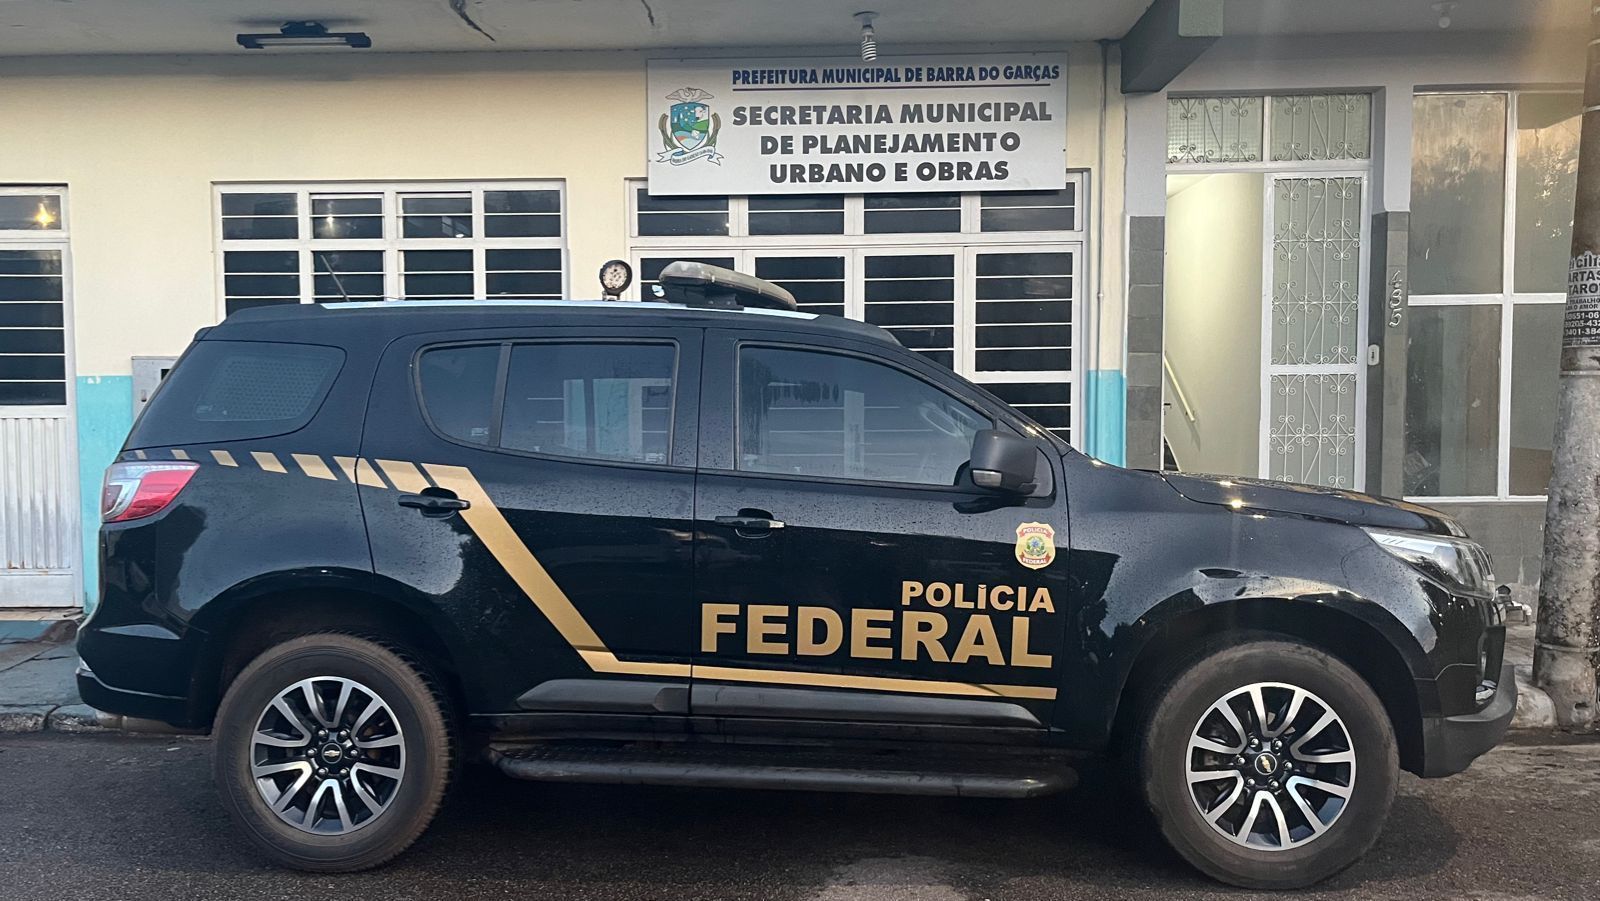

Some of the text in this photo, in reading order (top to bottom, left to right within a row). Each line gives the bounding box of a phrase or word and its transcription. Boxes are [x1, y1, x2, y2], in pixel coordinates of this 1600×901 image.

[732, 65, 1059, 85] PREFEITURA MUNICIPAL DE BARRA DO GARÇAS
[732, 101, 1052, 126] SECRETARIA MUNICIPAL
[760, 132, 1021, 155] DE PLANEJAMENTO
[769, 160, 1009, 183] URBANO E OBRAS
[1568, 283, 1600, 296] TARO
[701, 602, 1053, 668] FEDERAL
